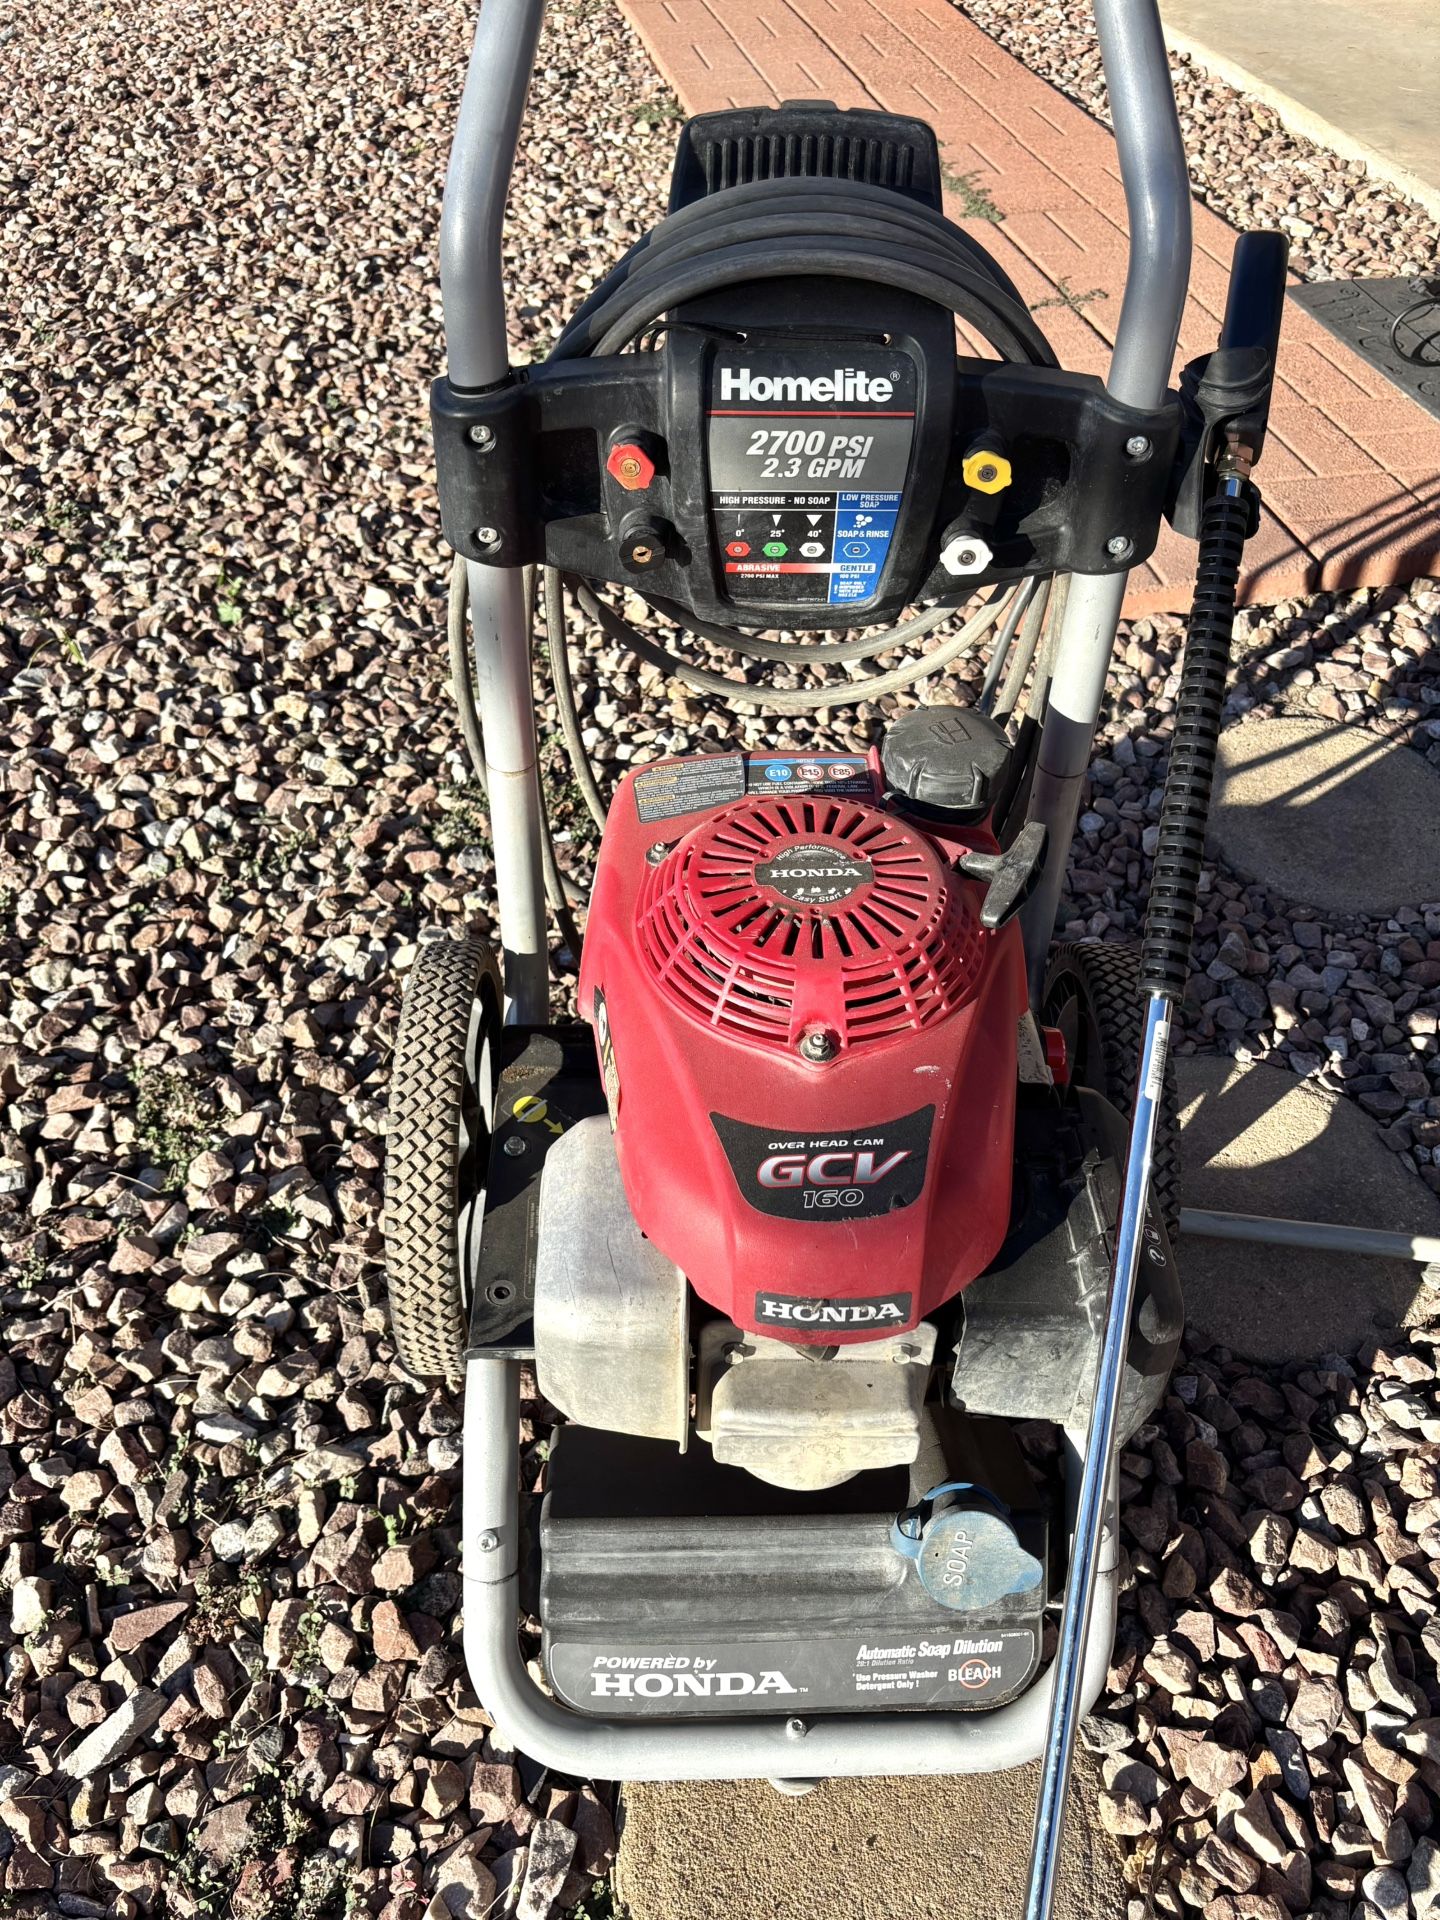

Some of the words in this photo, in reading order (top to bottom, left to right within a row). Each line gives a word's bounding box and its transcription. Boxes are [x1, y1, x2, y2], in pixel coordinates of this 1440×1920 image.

[746, 430, 826, 456] 2700
[828, 435, 874, 458] PSI
[760, 457, 803, 478] 2.3
[807, 457, 866, 479] GPM
[719, 496, 740, 505] HIGH
[742, 496, 786, 505] PRESSURE
[793, 496, 806, 505] NO
[807, 496, 831, 505] SOAP
[860, 494, 899, 502] PRESSURE
[837, 530, 859, 538] SOAP
[858, 530, 865, 538] &
[866, 530, 890, 538] RINSE
[736, 564, 781, 572] ABRASIVE
[840, 564, 873, 572] GENTLE
[769, 769, 788, 777] E10
[801, 768, 820, 776] E15
[832, 768, 851, 776] E85
[776, 849, 793, 861] High
[794, 843, 846, 860] Performance
[769, 867, 863, 878] HONDA
[792, 893, 815, 904] Easy
[818, 892, 842, 903] Start
[768, 1141, 805, 1150] OVER
[809, 1139, 848, 1148] HEAD
[853, 1138, 884, 1146] CAM
[757, 1150, 913, 1189] GCV
[803, 1188, 864, 1208] 160
[761, 1299, 904, 1322] HONDA
[942, 1529, 974, 1587] SOAP
[856, 1644, 917, 1660] Automatic
[918, 1641, 951, 1658] Soap
[953, 1639, 1003, 1655] Dilution
[593, 1656, 690, 1669] POWERED
[692, 1656, 718, 1670] by
[871, 1659, 896, 1667] Dilution
[897, 1658, 914, 1666] Ratio
[872, 1672, 907, 1681] Pressure
[909, 1670, 938, 1679] Washer
[948, 1666, 1002, 1682] BLEACH
[856, 1681, 896, 1691] Detergent
[897, 1680, 914, 1690] Only
